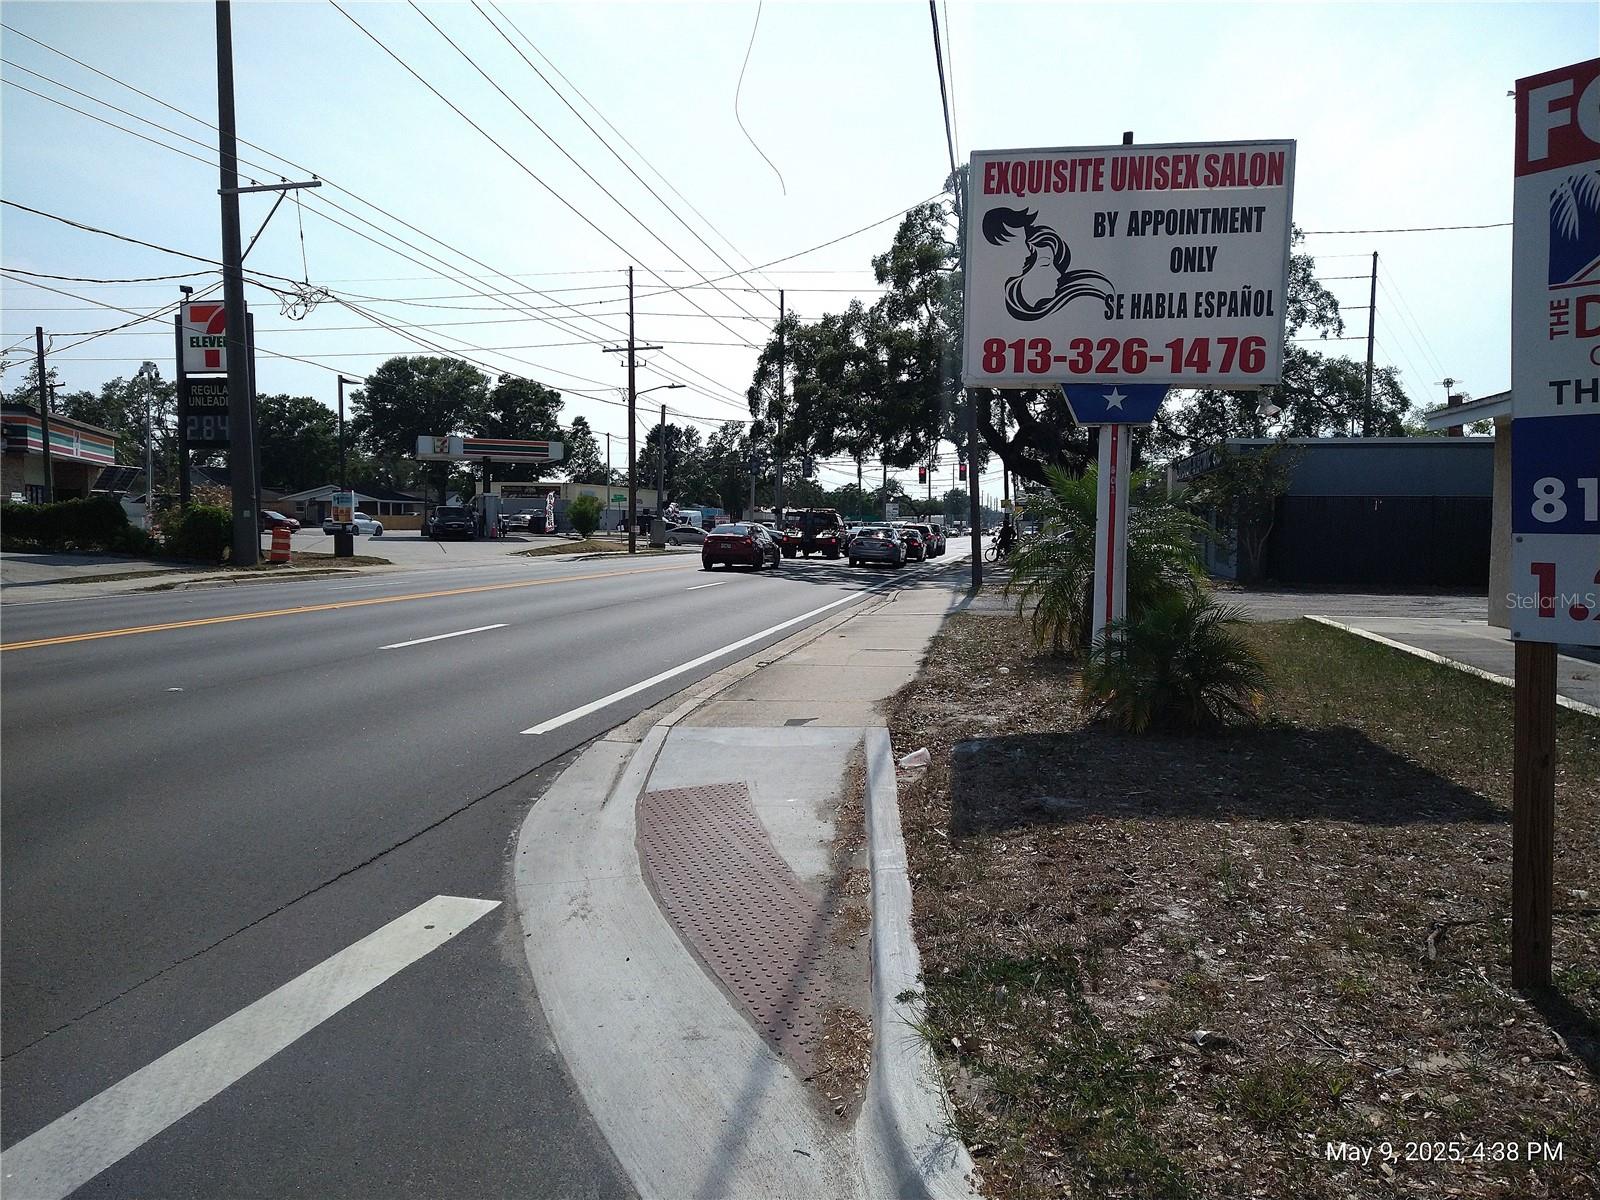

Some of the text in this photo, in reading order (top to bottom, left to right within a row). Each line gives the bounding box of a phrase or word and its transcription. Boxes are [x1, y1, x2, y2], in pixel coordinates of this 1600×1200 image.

[983, 151, 1285, 197] EXQUISITE UNISEX SALON
[1093, 206, 1266, 238] BY APPOINTMENT
[1170, 246, 1218, 274] ONLY
[1104, 285, 1274, 320] SE HABLA ESPAÑOL
[1550, 298, 1569, 340] THE
[982, 336, 1267, 374] 813-326-1476
[191, 385, 228, 395] REGULA
[1531, 477, 1598, 523] 81
[1530, 562, 1600, 621] 1.
